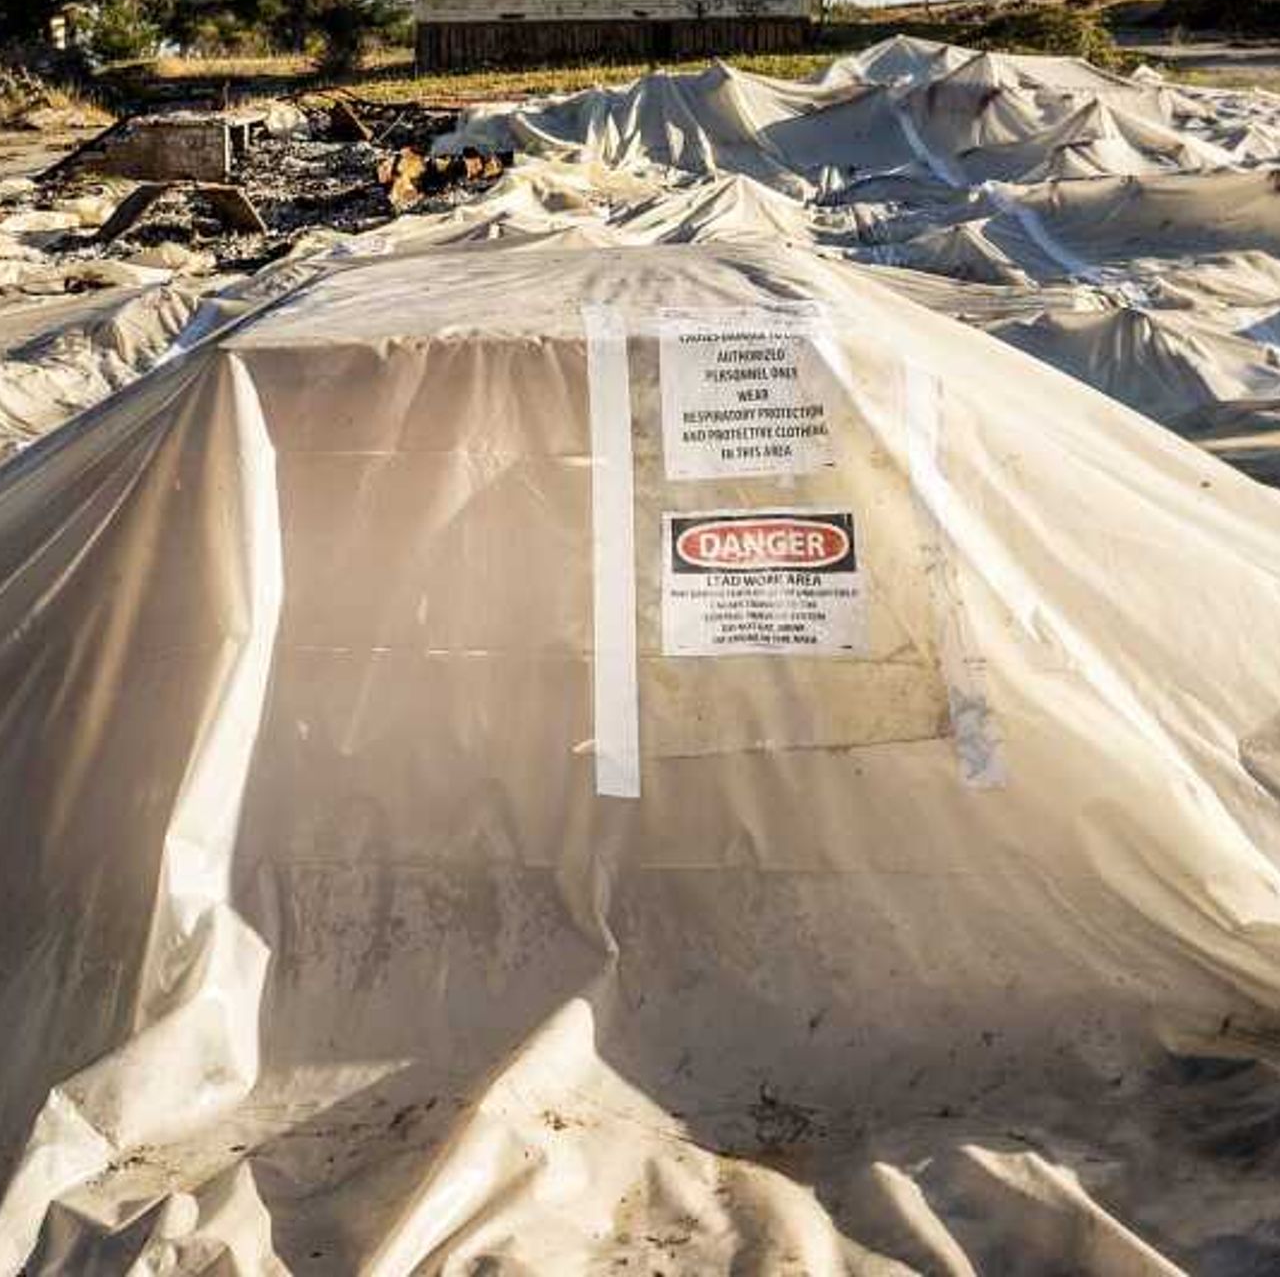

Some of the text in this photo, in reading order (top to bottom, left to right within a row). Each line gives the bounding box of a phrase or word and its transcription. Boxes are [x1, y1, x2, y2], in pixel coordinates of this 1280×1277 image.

[717, 348, 785, 363] AUTHORIZED
[705, 366, 797, 382] PERSONNEL ONLY
[736, 389, 769, 402] WEAR
[683, 405, 824, 423] RESPIRATORY PROTECTION
[683, 424, 828, 442] AND PROTECTIVE CLOTHING
[763, 445, 792, 458] AREA
[699, 529, 826, 559] DANGER
[786, 574, 822, 586] AREA
